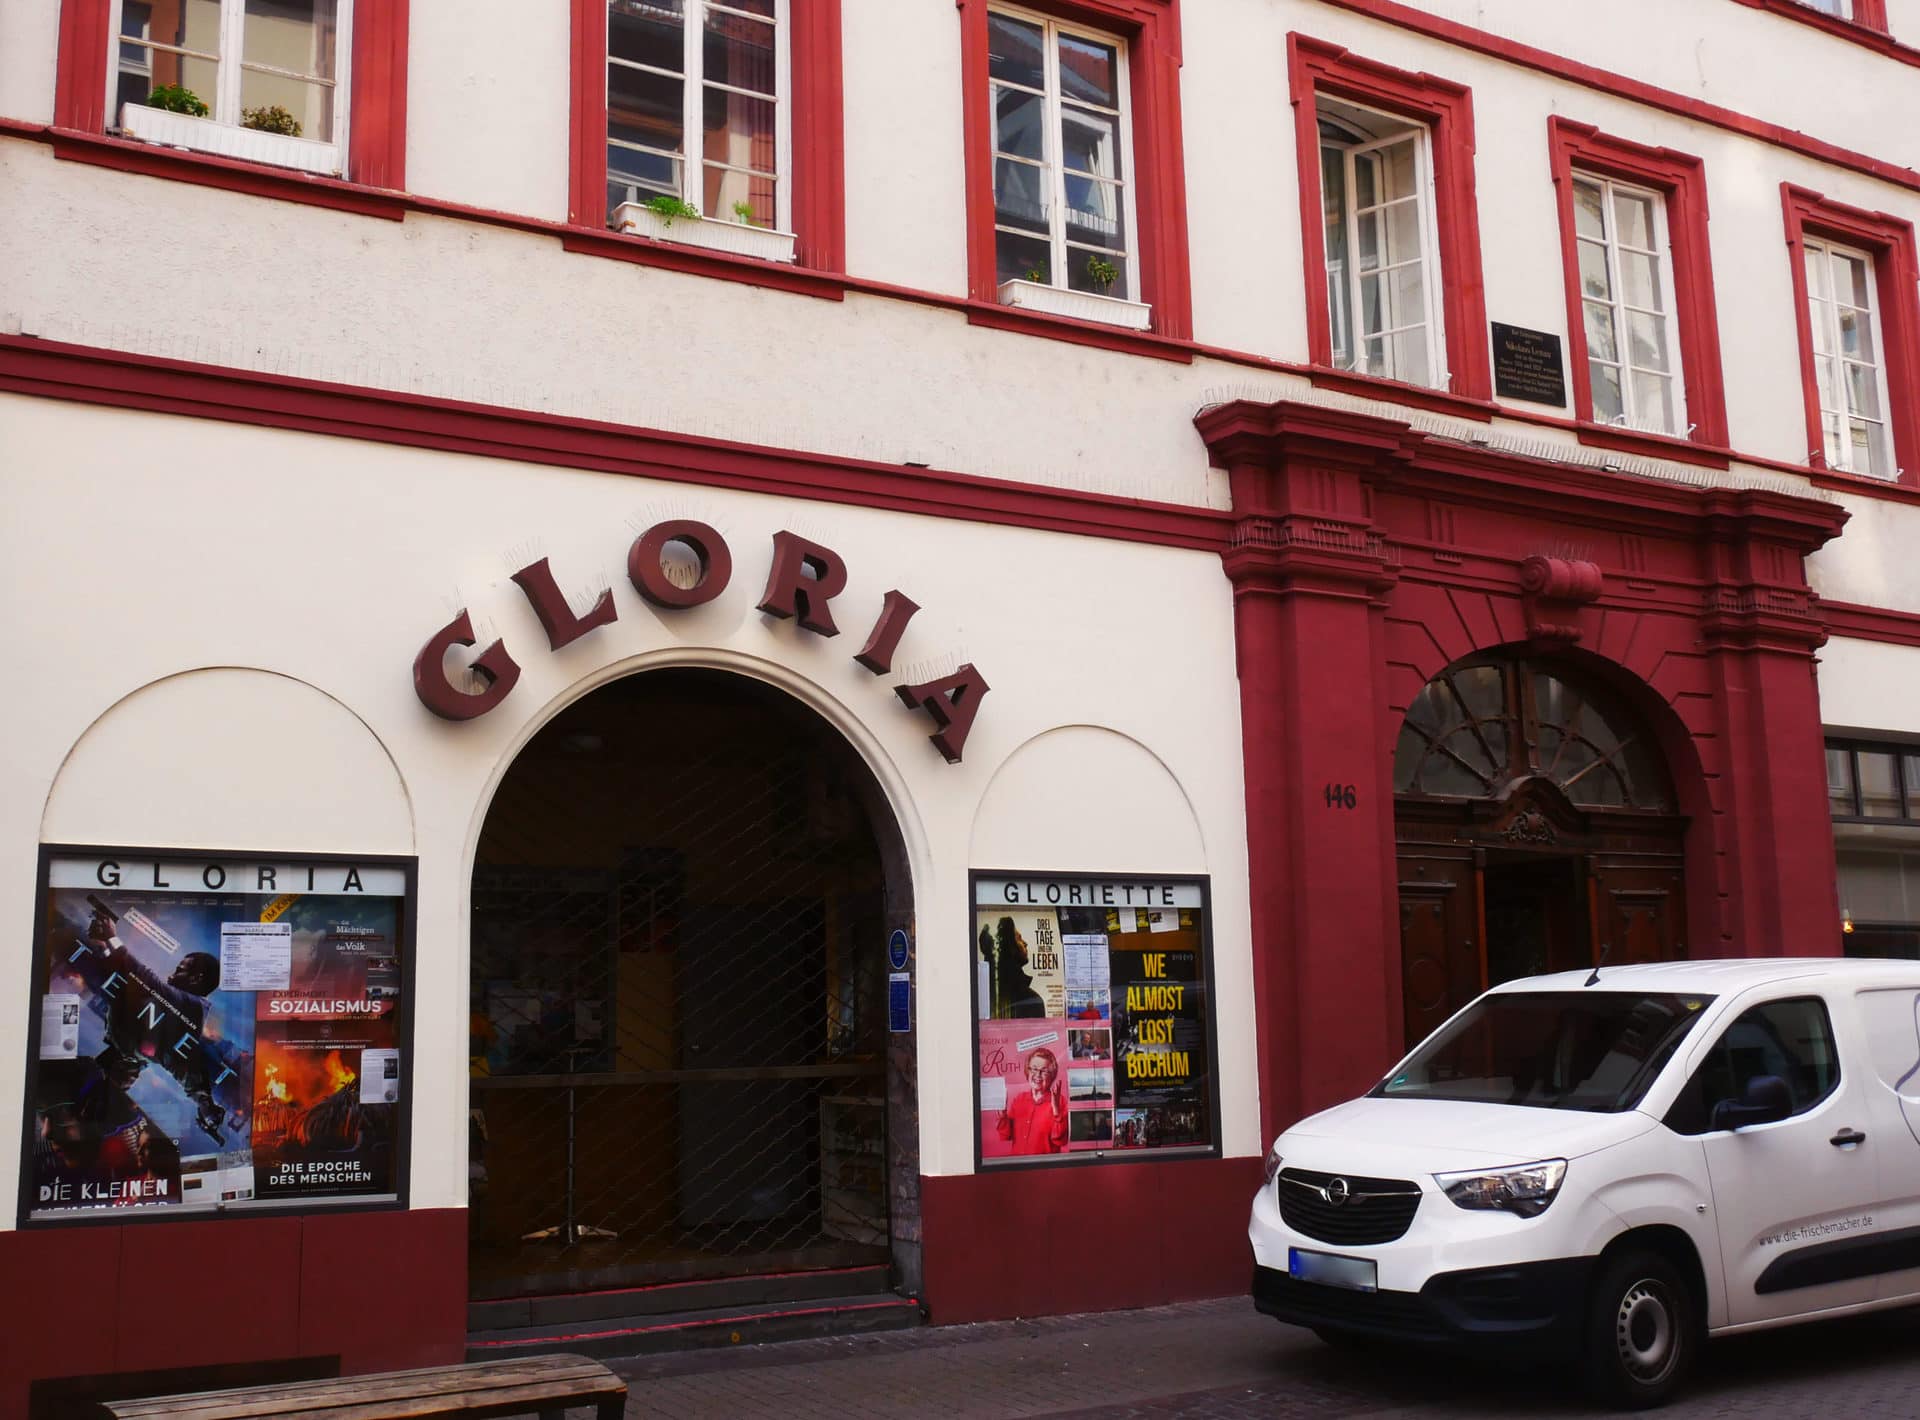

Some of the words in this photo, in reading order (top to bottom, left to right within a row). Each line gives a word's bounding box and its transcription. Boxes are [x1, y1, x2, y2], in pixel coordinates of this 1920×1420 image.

[413, 519, 991, 764] GLORIA
[1325, 783, 1357, 810] 146
[96, 860, 364, 892] GLORIA
[1003, 882, 1175, 905] GLORIETTE
[1036, 918, 1051, 930] DREI
[345, 941, 367, 952] Volk
[1034, 930, 1055, 946] TAGE
[1032, 952, 1059, 970] LEBEN
[1142, 953, 1167, 978] WE
[269, 1000, 382, 1014] SOZIALISMUS
[1125, 986, 1185, 1011] ALMOST
[68, 939, 238, 1085] TENET
[1138, 1018, 1174, 1044] LOST
[1126, 1052, 1190, 1078] BOCHUM
[270, 1175, 295, 1185] DES
[300, 1172, 371, 1184] MENSCHEN
[281, 1162, 303, 1174] DIE
[308, 1160, 361, 1173] EPOCHE
[39, 1178, 72, 1201] DIE
[81, 1178, 168, 1200] KLEINEN
[1759, 1215, 1873, 1246] www.die-frischemacher.de
